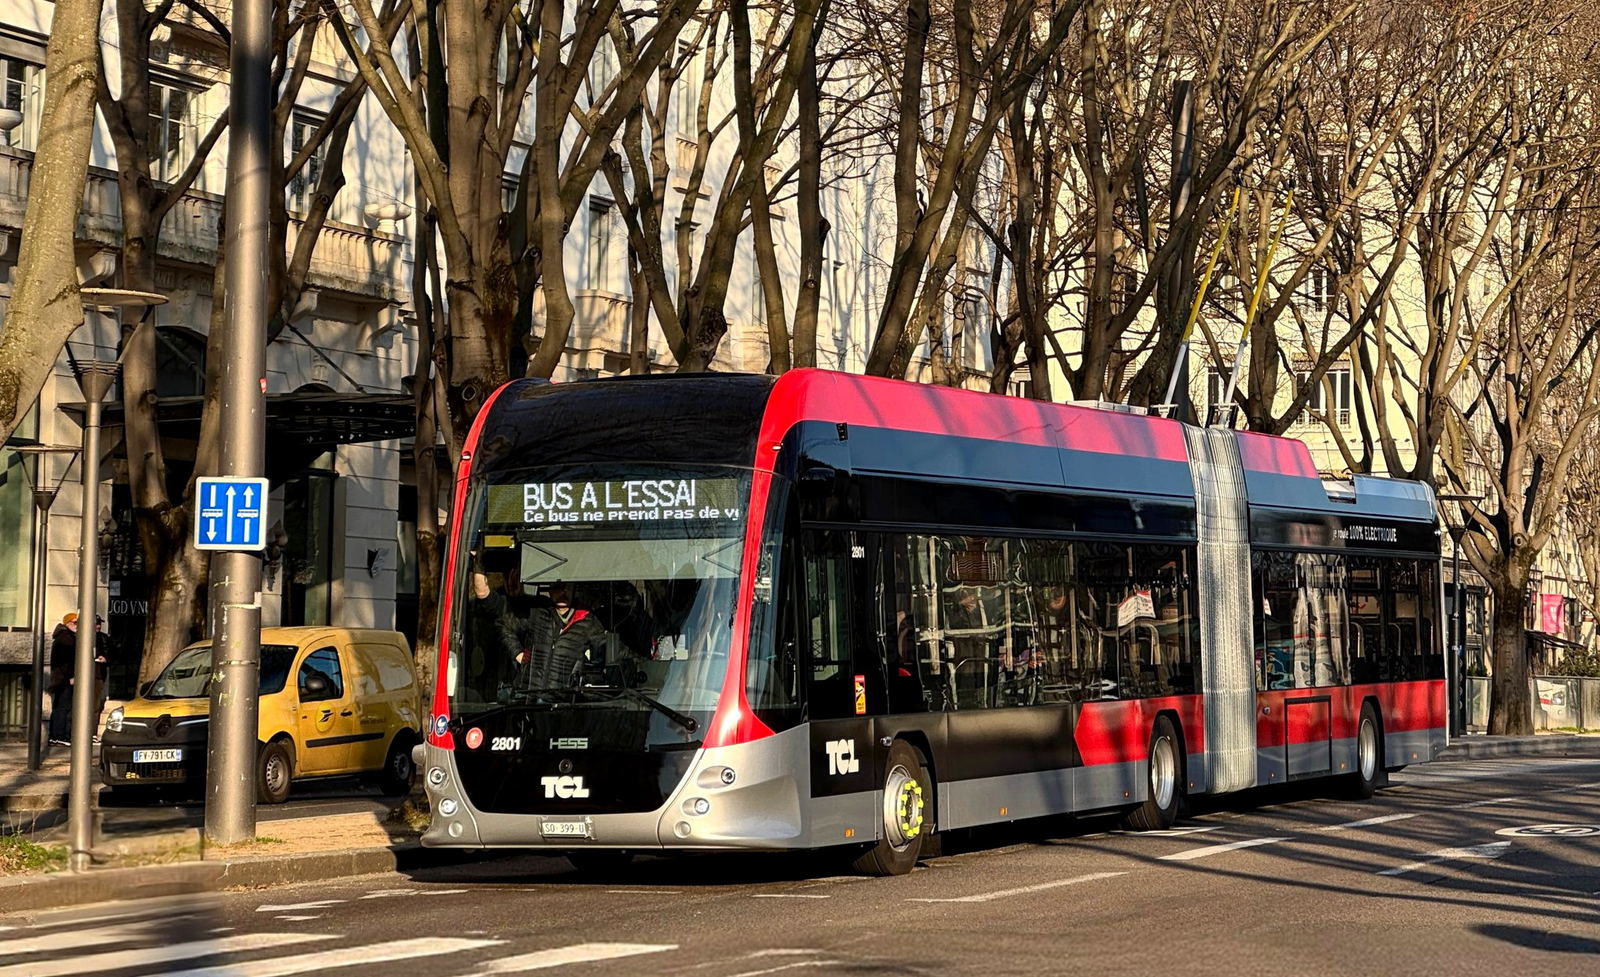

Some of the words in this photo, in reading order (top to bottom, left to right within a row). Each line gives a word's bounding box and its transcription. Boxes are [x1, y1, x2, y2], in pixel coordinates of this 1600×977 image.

[523, 483, 573, 510] BUS
[580, 482, 598, 509] A
[605, 479, 696, 508] L'ESSAI
[523, 510, 545, 523] Ce
[548, 509, 579, 522] bus
[583, 511, 604, 521] ne
[608, 506, 659, 521] prend
[663, 509, 695, 520] pas
[698, 505, 720, 519] de
[1349, 525, 1364, 540] 100%
[851, 545, 865, 559] 2801
[491, 736, 521, 751] 2801
[549, 737, 589, 750] HESS
[825, 738, 860, 776] TCL
[540, 775, 590, 799] TCL
